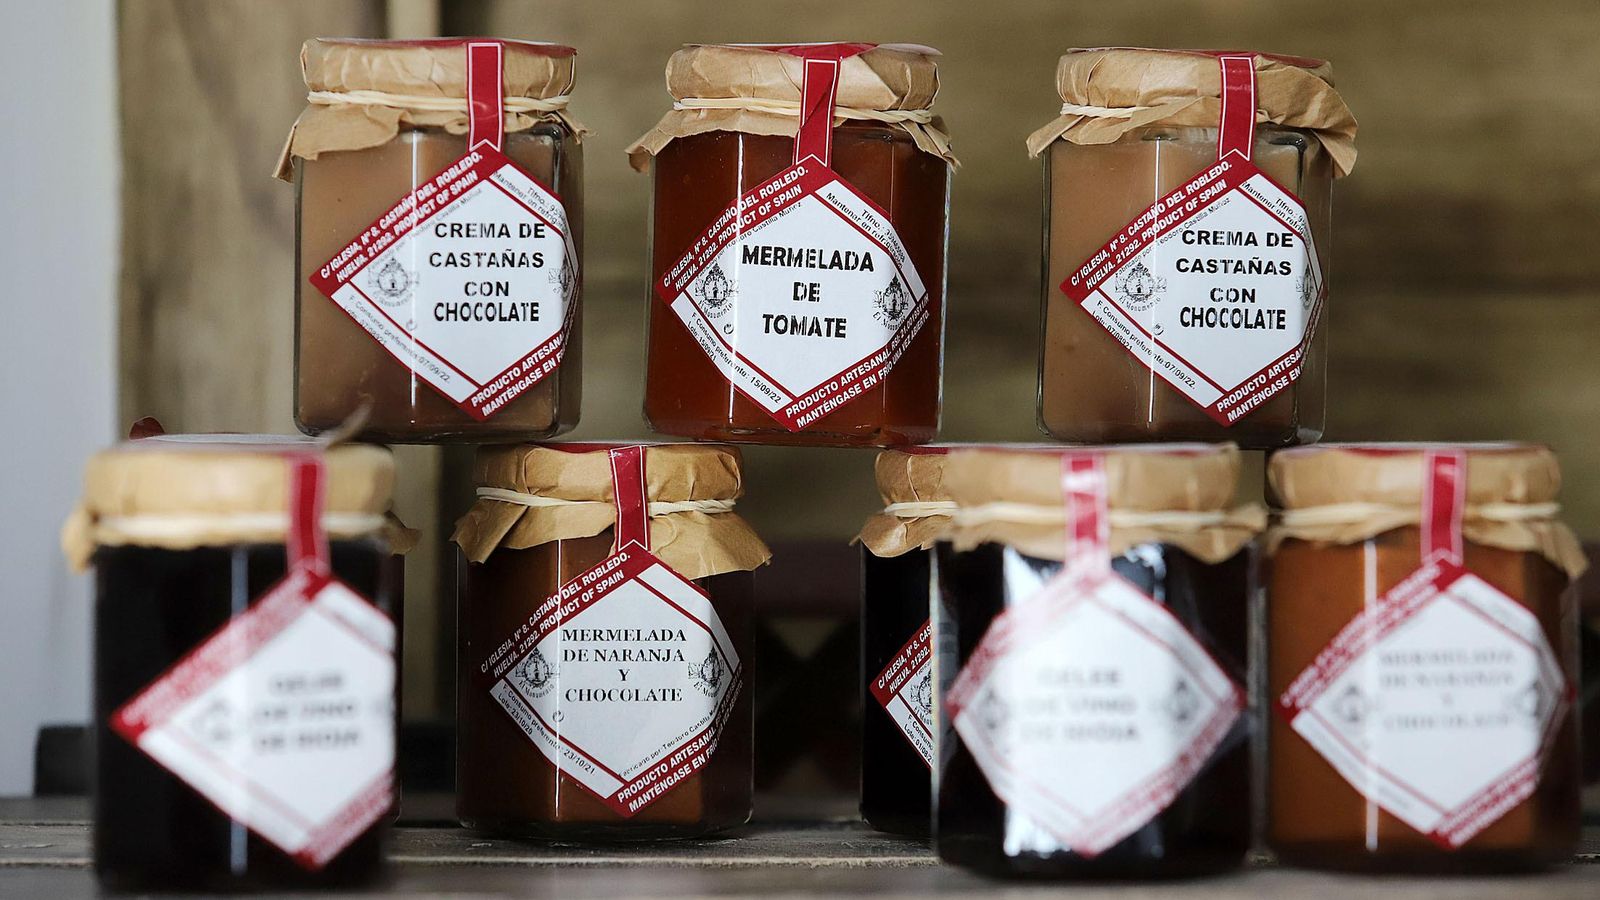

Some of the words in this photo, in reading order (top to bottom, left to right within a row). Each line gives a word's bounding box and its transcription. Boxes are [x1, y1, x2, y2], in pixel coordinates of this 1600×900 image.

[393, 199, 436, 236] PRODUCT
[435, 189, 450, 205] OF
[450, 169, 479, 196] SPAIN
[416, 182, 438, 201] DEL
[826, 191, 862, 224] Mantener
[1183, 211, 1209, 229] Castilla
[435, 223, 511, 238] CREMA
[519, 223, 546, 238] DE
[662, 272, 672, 289] C/
[708, 205, 739, 240] CASTAÑO
[739, 193, 760, 213] DEL
[758, 165, 809, 200] ROBLEDO.
[674, 262, 699, 293] HUELVA.
[698, 241, 719, 268] 21292.
[718, 210, 757, 246] PRODUCT
[758, 201, 772, 217] OF
[772, 183, 804, 208] SPAIN
[1070, 274, 1081, 288] C/
[1079, 248, 1111, 280] IGLESIA,
[1119, 232, 1129, 244] 8.
[1127, 201, 1166, 237] CASTAÑO
[1165, 189, 1187, 208] DEL
[1185, 163, 1233, 196] ROBLEDO.
[1085, 261, 1116, 291] HUELVA.
[1115, 239, 1142, 265] 21292.
[1141, 207, 1184, 243] PRODUCT
[1184, 199, 1199, 213] OF
[1198, 179, 1228, 204] SPAIN
[1182, 229, 1259, 247] CREMA
[1266, 232, 1294, 248] DE
[430, 248, 544, 268] CASTAÑAS
[742, 245, 875, 273] MERMELADA
[1176, 256, 1292, 276] CASTAÑAS
[465, 282, 510, 297] CON
[793, 282, 820, 303] DE
[1210, 288, 1256, 304] CON
[434, 302, 540, 323] CHOCOLATE
[763, 314, 847, 339] TOMATE
[1103, 306, 1131, 336] Consumo
[1180, 307, 1286, 330] CHOCOLATE
[696, 317, 718, 347] Consumo
[749, 376, 783, 404] 15/09/22
[471, 368, 522, 408] PRODUCTO
[481, 369, 545, 417] MANTÉNGASE
[541, 356, 557, 373] EN
[785, 381, 839, 419] PRODUCTO
[1216, 374, 1267, 413] PRODUCTO
[1226, 376, 1290, 422] MANTÉNGASE
[1289, 366, 1302, 382] EN
[796, 382, 863, 430] MANTÉNGASE
[862, 374, 878, 392] EN
[480, 660, 490, 674] C/
[488, 638, 515, 668] IGLESIA,
[521, 623, 531, 634] 8.
[528, 595, 561, 627] CASTAÑO
[561, 582, 583, 600] DEL
[581, 551, 631, 587] ROBLEDO.
[493, 650, 520, 679] HUELVA.
[519, 629, 541, 655] 21292.
[539, 597, 579, 634] PRODUCT
[580, 587, 594, 604] OF
[594, 569, 625, 594] SPAIN
[562, 629, 687, 642] MERMELADA
[563, 649, 589, 662] DE
[594, 649, 685, 662] NARANJA
[889, 667, 911, 694] HUELVA.
[910, 645, 930, 670] 21292.
[618, 669, 631, 682] Y
[878, 676, 886, 690] C/
[508, 690, 532, 720] Consumo
[565, 688, 683, 702] CHOCOLATE
[617, 763, 669, 803] PRODUCTO
[628, 763, 692, 812] MANTÉNGASE
[691, 753, 706, 770] EN
